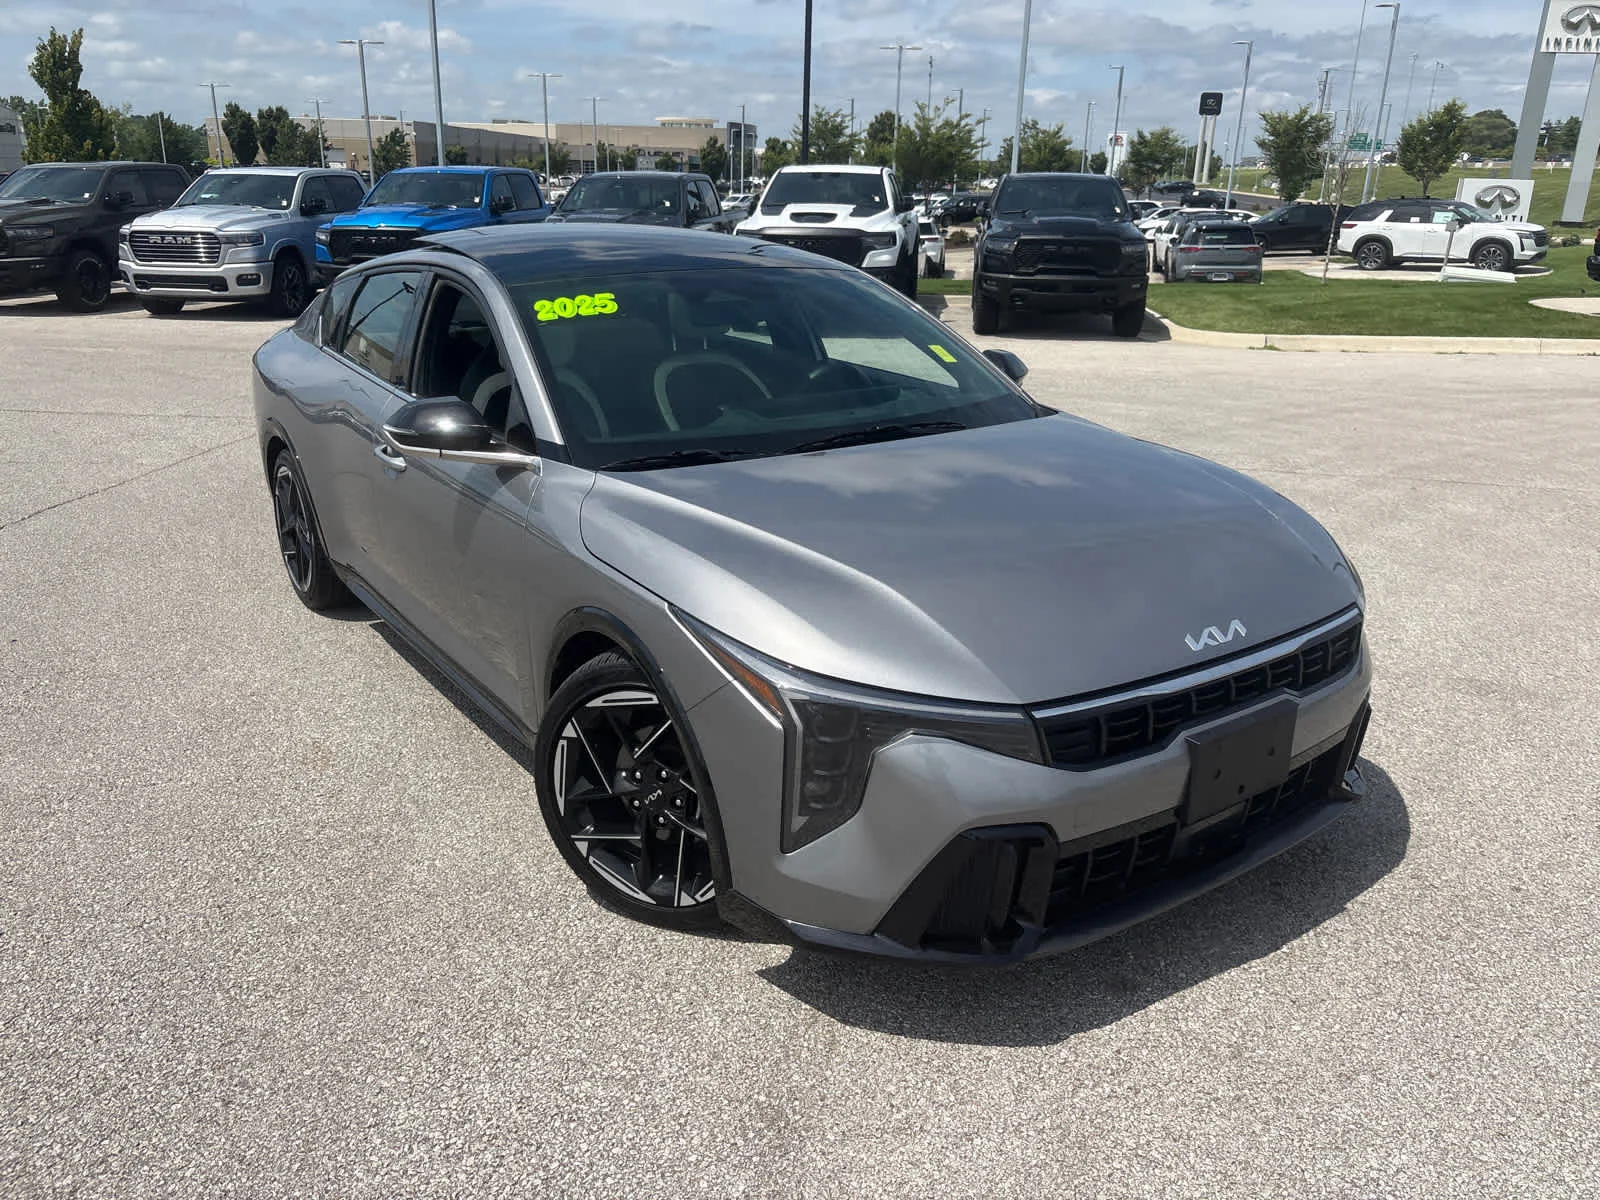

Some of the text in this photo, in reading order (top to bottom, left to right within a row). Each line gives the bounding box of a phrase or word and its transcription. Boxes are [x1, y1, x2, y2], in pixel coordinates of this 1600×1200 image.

[148, 236, 192, 245] RAM
[533, 292, 619, 322] 2025
[1184, 619, 1248, 652] KIA
